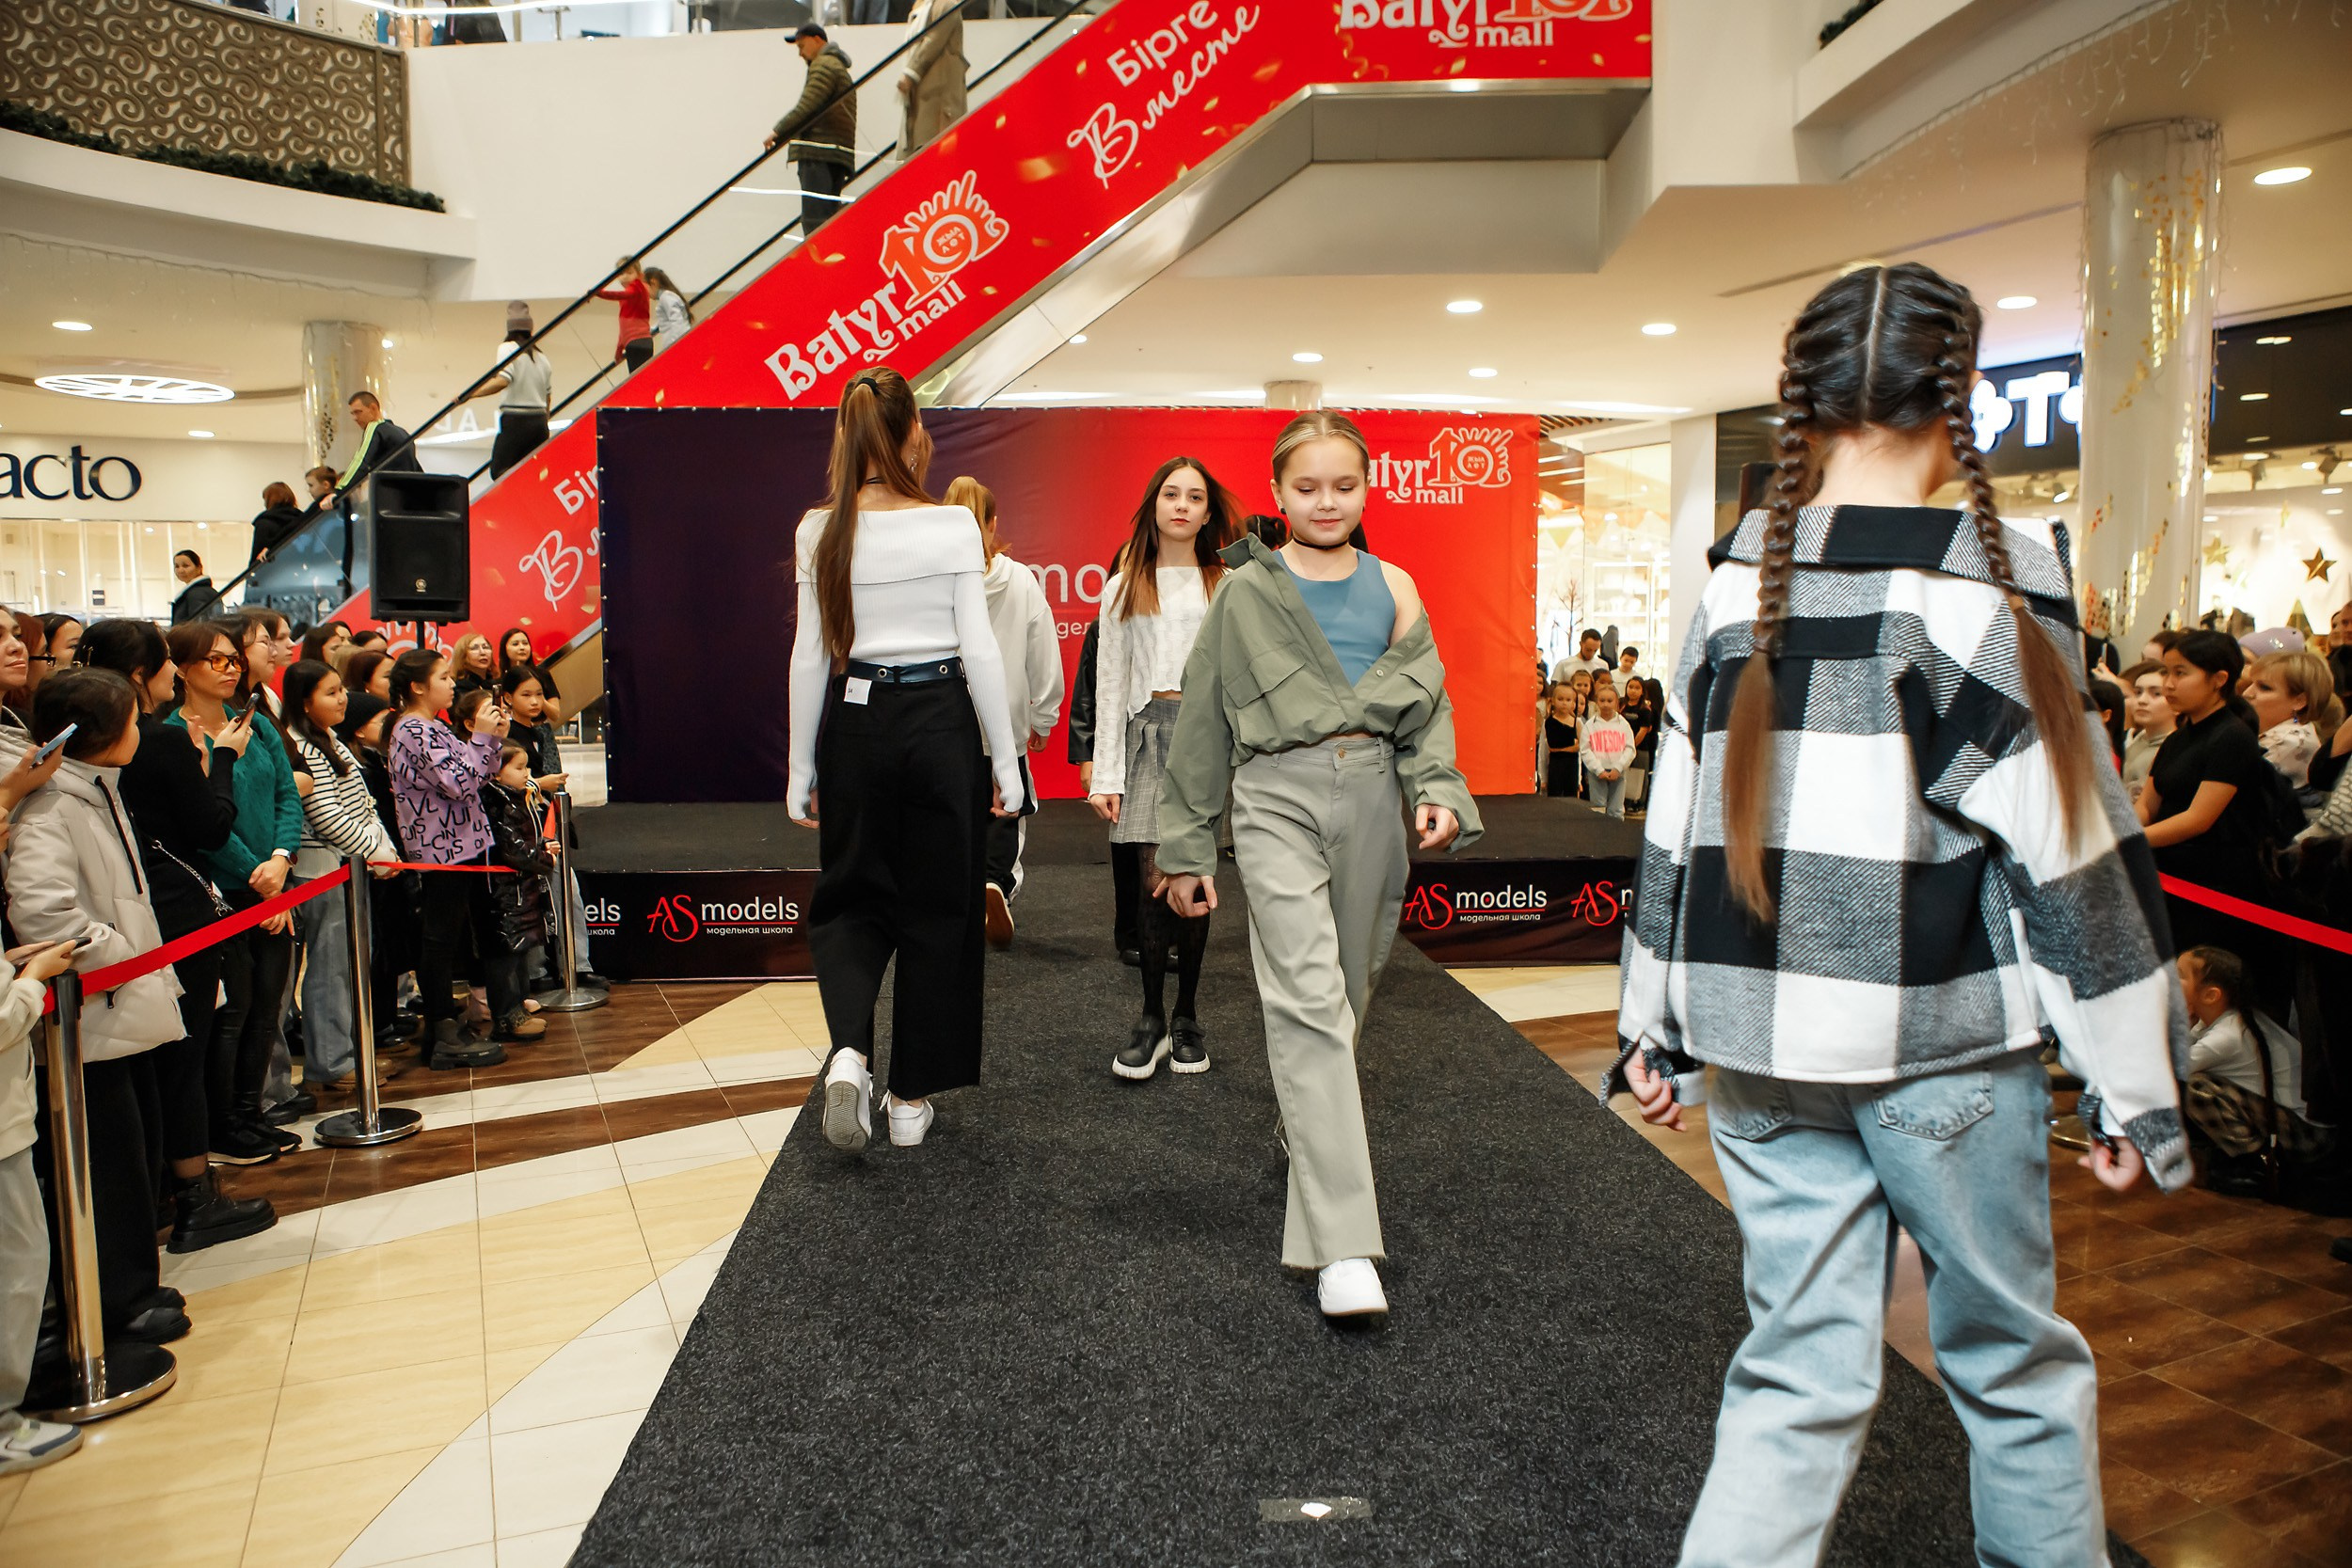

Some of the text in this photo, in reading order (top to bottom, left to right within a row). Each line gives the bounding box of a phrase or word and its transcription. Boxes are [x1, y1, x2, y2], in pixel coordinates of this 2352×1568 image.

[1106, 0, 1218, 87] Бірге
[1476, 21, 1552, 46] mall
[1067, 5, 1260, 189] Вместе
[897, 279, 966, 341] mall
[764, 281, 903, 401] Batyr
[0, 445, 142, 501] acto
[1415, 486, 1464, 504] mall
[647, 895, 799, 942] AS models
[1405, 883, 1548, 930] AS models
[1460, 915, 1510, 924] модельная
[1570, 880, 1619, 927] AS
[707, 927, 760, 936] модельная
